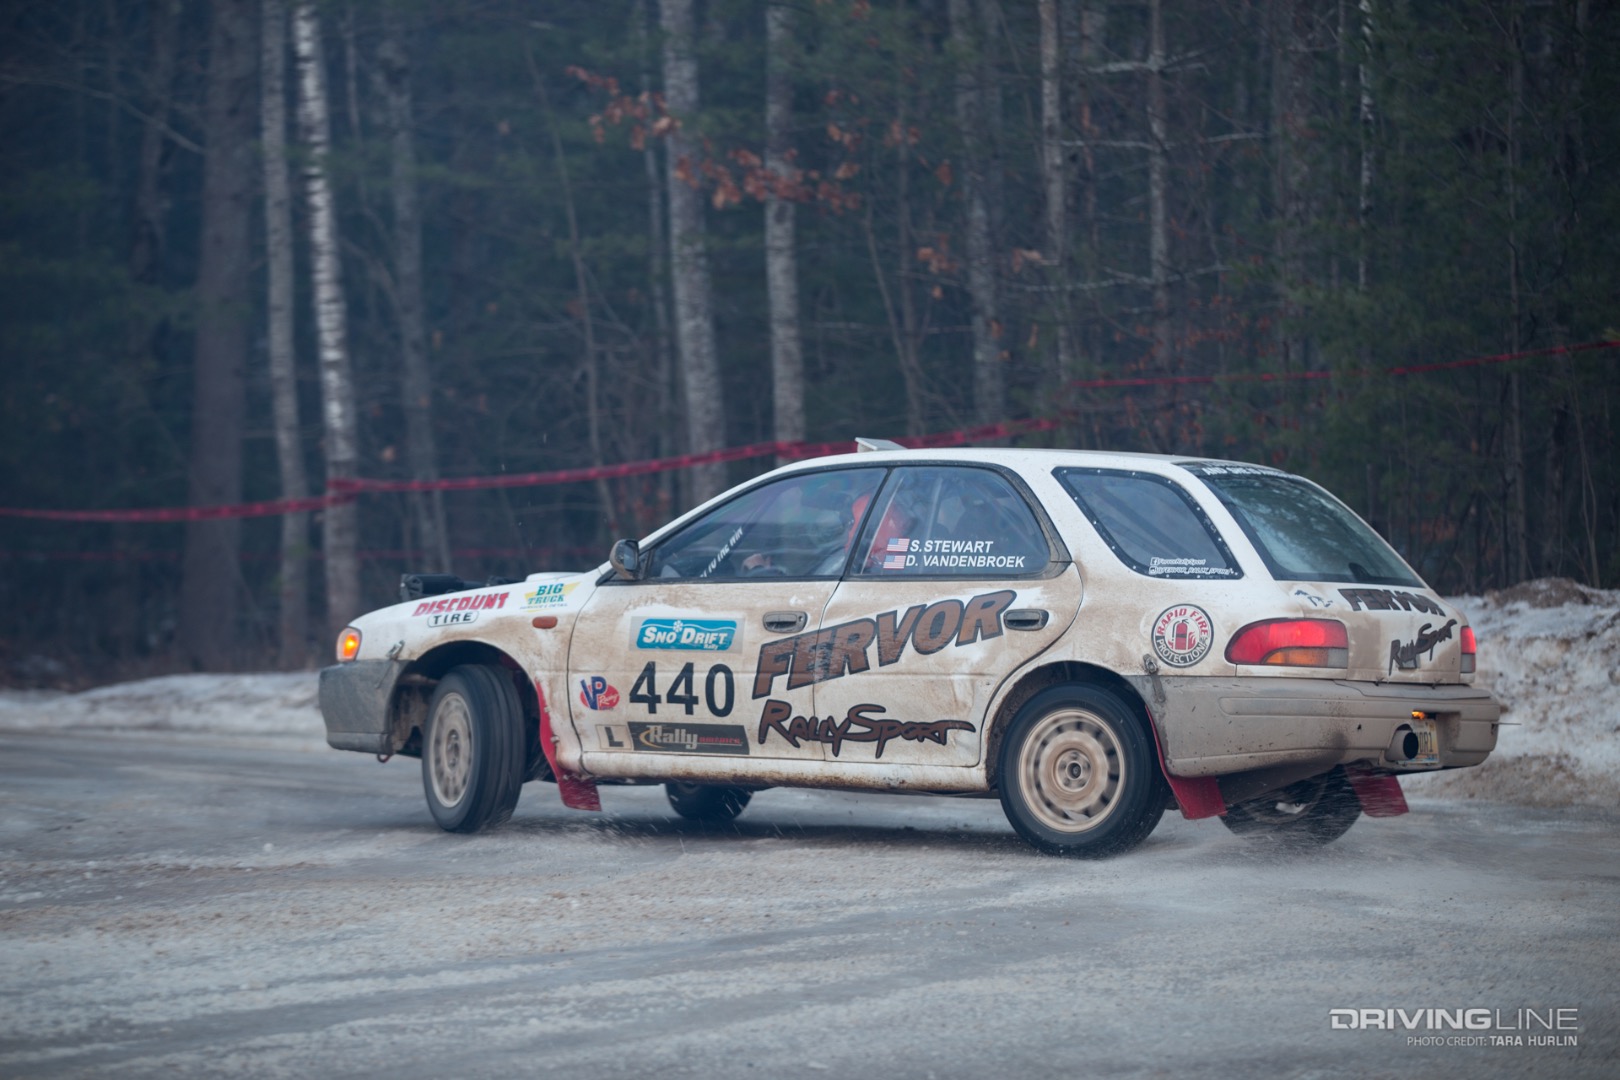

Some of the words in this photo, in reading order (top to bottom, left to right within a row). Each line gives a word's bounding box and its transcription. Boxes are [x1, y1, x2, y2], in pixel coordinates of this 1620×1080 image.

[906, 555, 918, 567] D.
[923, 555, 1025, 568] VANDENBROEK
[528, 594, 566, 605] TRUCK
[536, 583, 565, 596] BIG
[412, 592, 510, 617] DISCOUNT
[1338, 588, 1446, 617] FERVOR
[433, 612, 474, 625] TIRE
[1156, 608, 1188, 636] RAPID
[1189, 610, 1209, 636] FIRE
[642, 626, 678, 644] SNO
[680, 628, 728, 645] DRIFT
[751, 589, 1017, 700] FERVOR
[1156, 638, 1207, 664] PROTECTION
[580, 676, 607, 710] VP
[629, 661, 735, 718] 440
[604, 726, 624, 748] L
[646, 725, 698, 750] Rally
